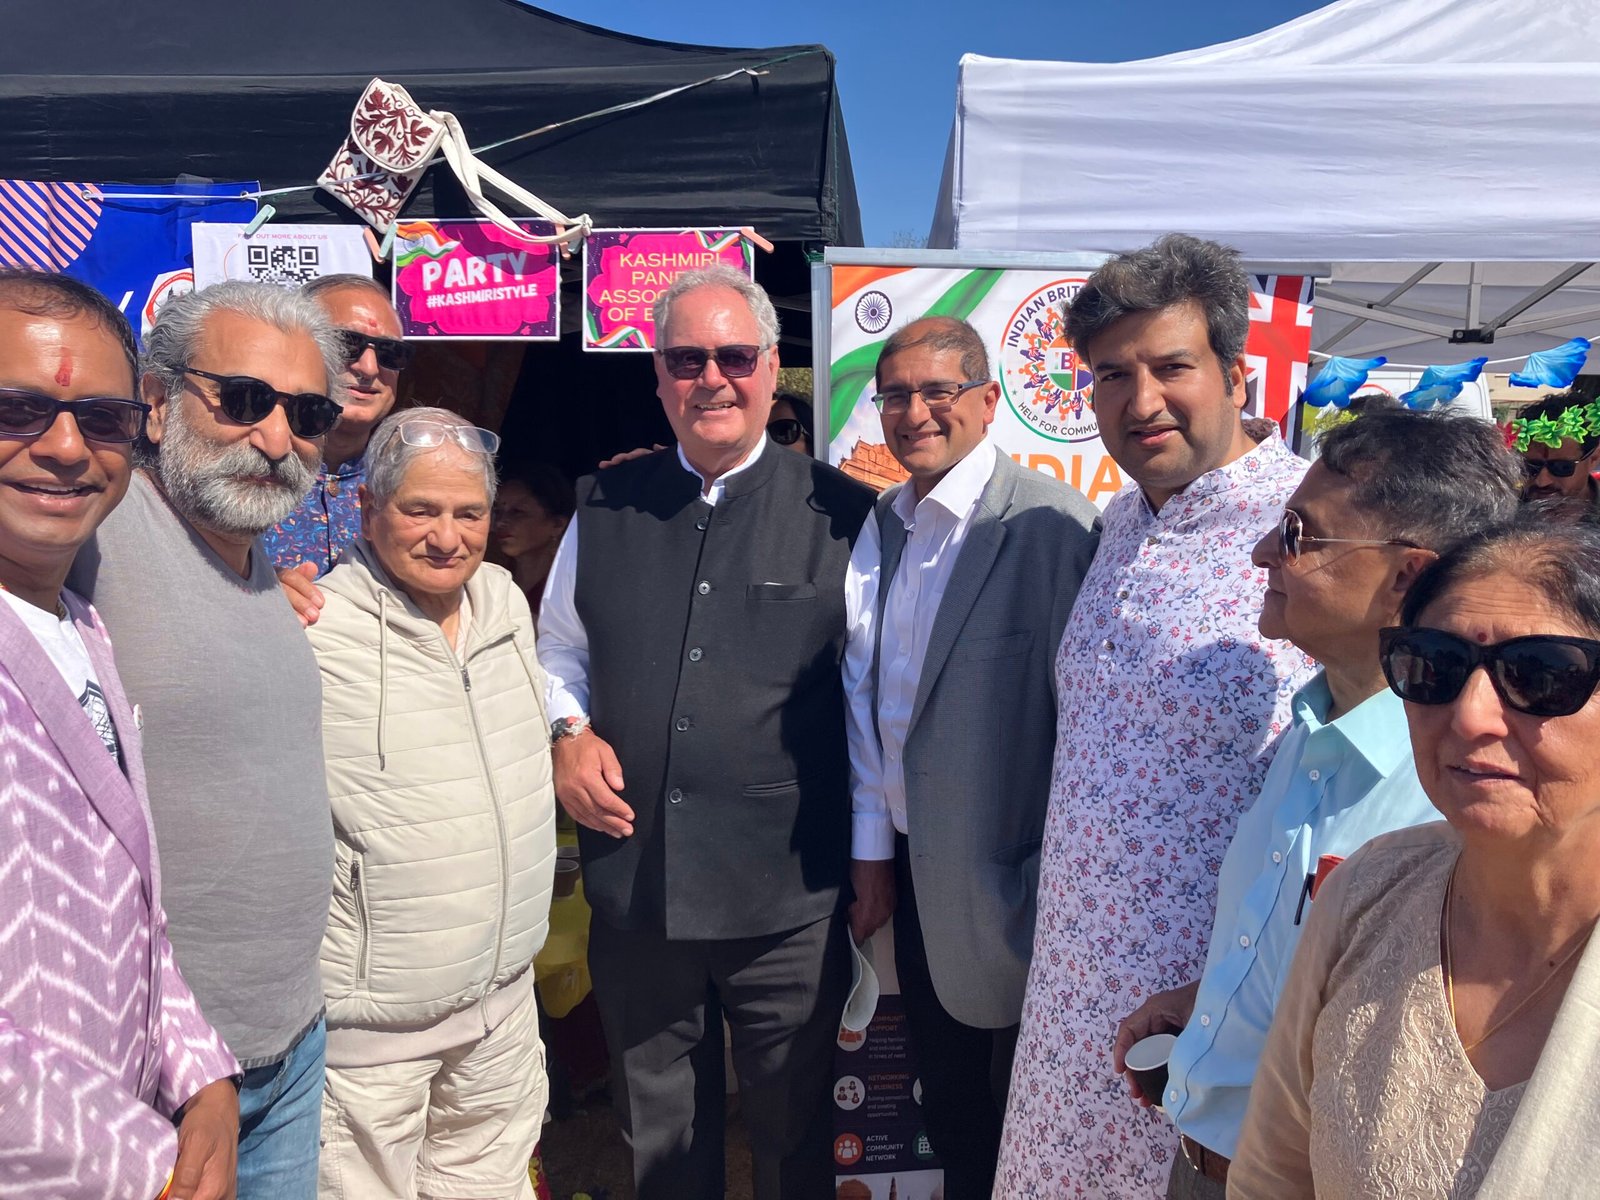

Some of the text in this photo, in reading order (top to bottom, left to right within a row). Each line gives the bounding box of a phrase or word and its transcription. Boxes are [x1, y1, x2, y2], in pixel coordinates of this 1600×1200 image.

[620, 252, 720, 268] KASHMIRI
[422, 251, 527, 291] PARTY
[631, 271, 685, 286] PAN
[426, 283, 538, 309] #KASHMIRISTYLE
[607, 307, 637, 322] OF
[1007, 296, 1046, 348] INDIAN
[1018, 401, 1039, 423] HELP
[1038, 420, 1058, 435] FOR
[866, 1134, 889, 1142] ACTIVE
[866, 1143, 904, 1152] COMMUNITY
[865, 1153, 897, 1162] NETWORK
